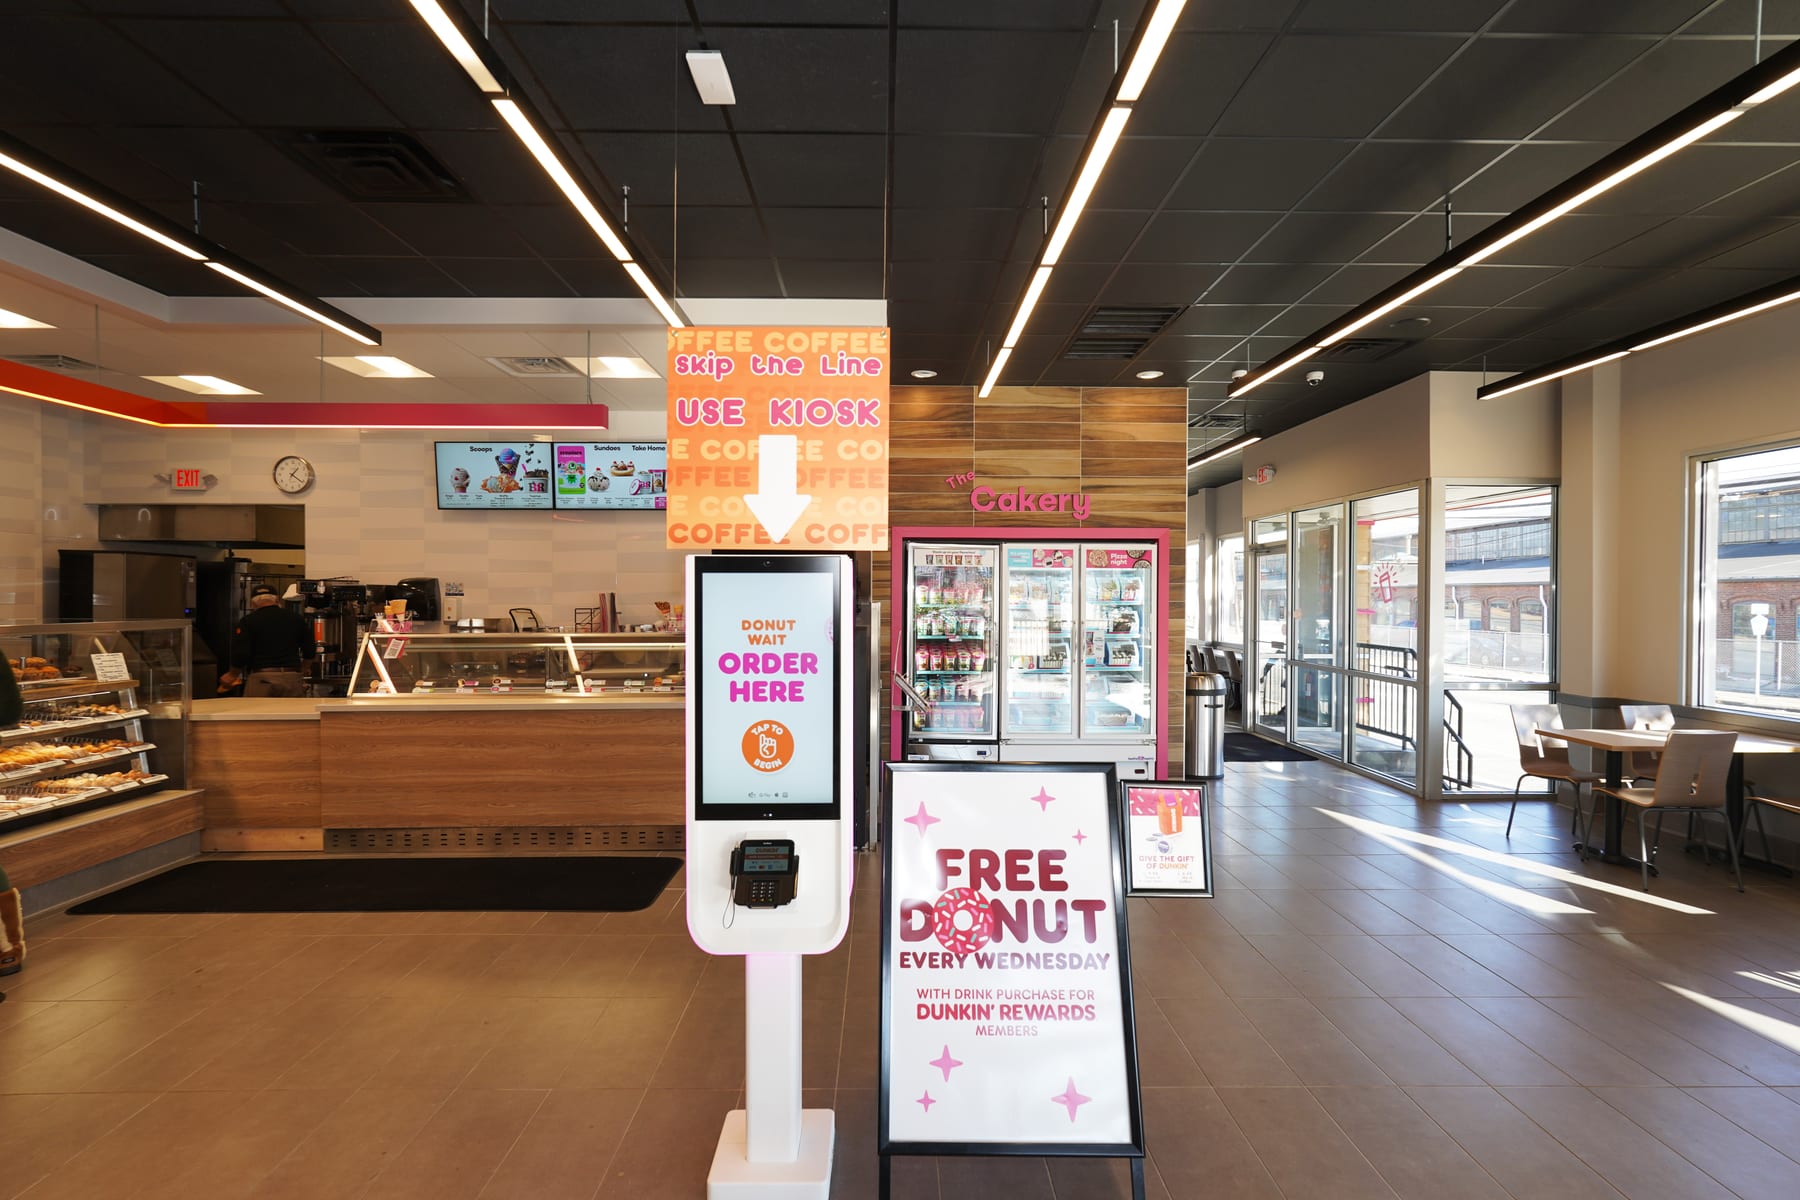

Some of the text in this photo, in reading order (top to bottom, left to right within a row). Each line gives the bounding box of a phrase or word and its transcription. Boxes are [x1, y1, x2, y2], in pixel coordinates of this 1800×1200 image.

[764, 332, 887, 354] COFFEE
[676, 351, 882, 381] Skip the Line
[677, 398, 881, 427] USE KIOSK
[176, 469, 200, 487] EXIT
[945, 471, 975, 489] The
[970, 485, 1091, 520] Cakery
[741, 619, 796, 631] DONUT
[747, 634, 787, 646] WAIT
[718, 652, 818, 675] ORDER
[729, 680, 805, 703] HERE
[750, 724, 784, 736] TAP TO
[753, 758, 783, 769] BEGIN
[936, 849, 1069, 891] FREE
[899, 951, 1110, 971] EVERY WEDNESDAY
[916, 988, 1095, 1001] WITH DRINK PURCHASE FOR
[916, 1003, 1096, 1021] DUNKIN' REWARDS
[975, 1025, 1038, 1036] MEMBERS
